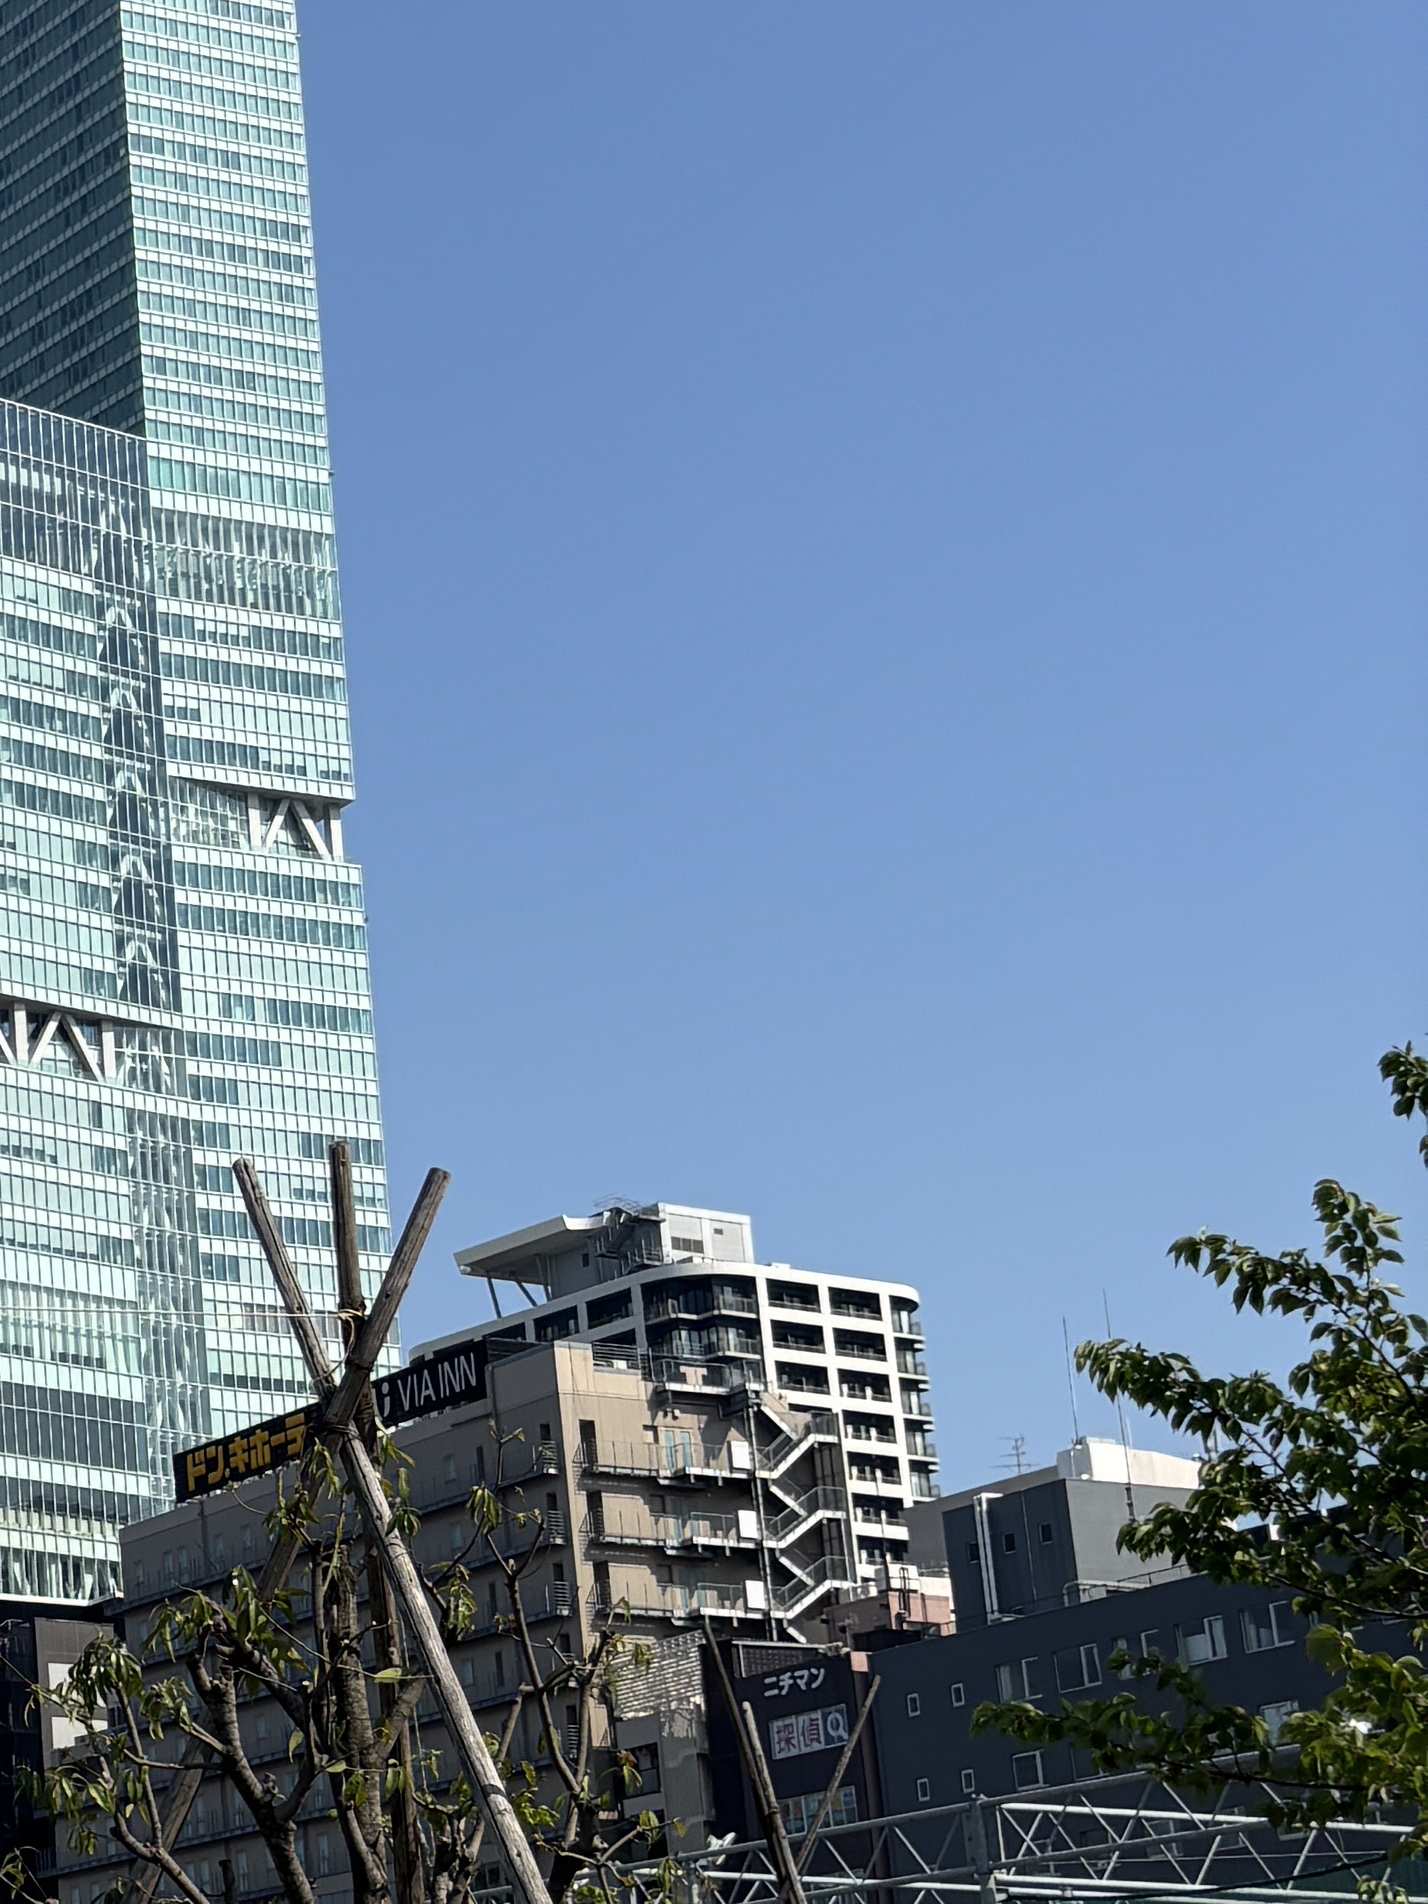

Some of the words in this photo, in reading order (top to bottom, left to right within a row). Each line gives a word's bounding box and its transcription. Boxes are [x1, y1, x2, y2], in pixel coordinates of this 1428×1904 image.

[397, 1369, 437, 1412] VIA
[439, 1352, 477, 1399] INN
[763, 1667, 826, 1698] ニチマン
